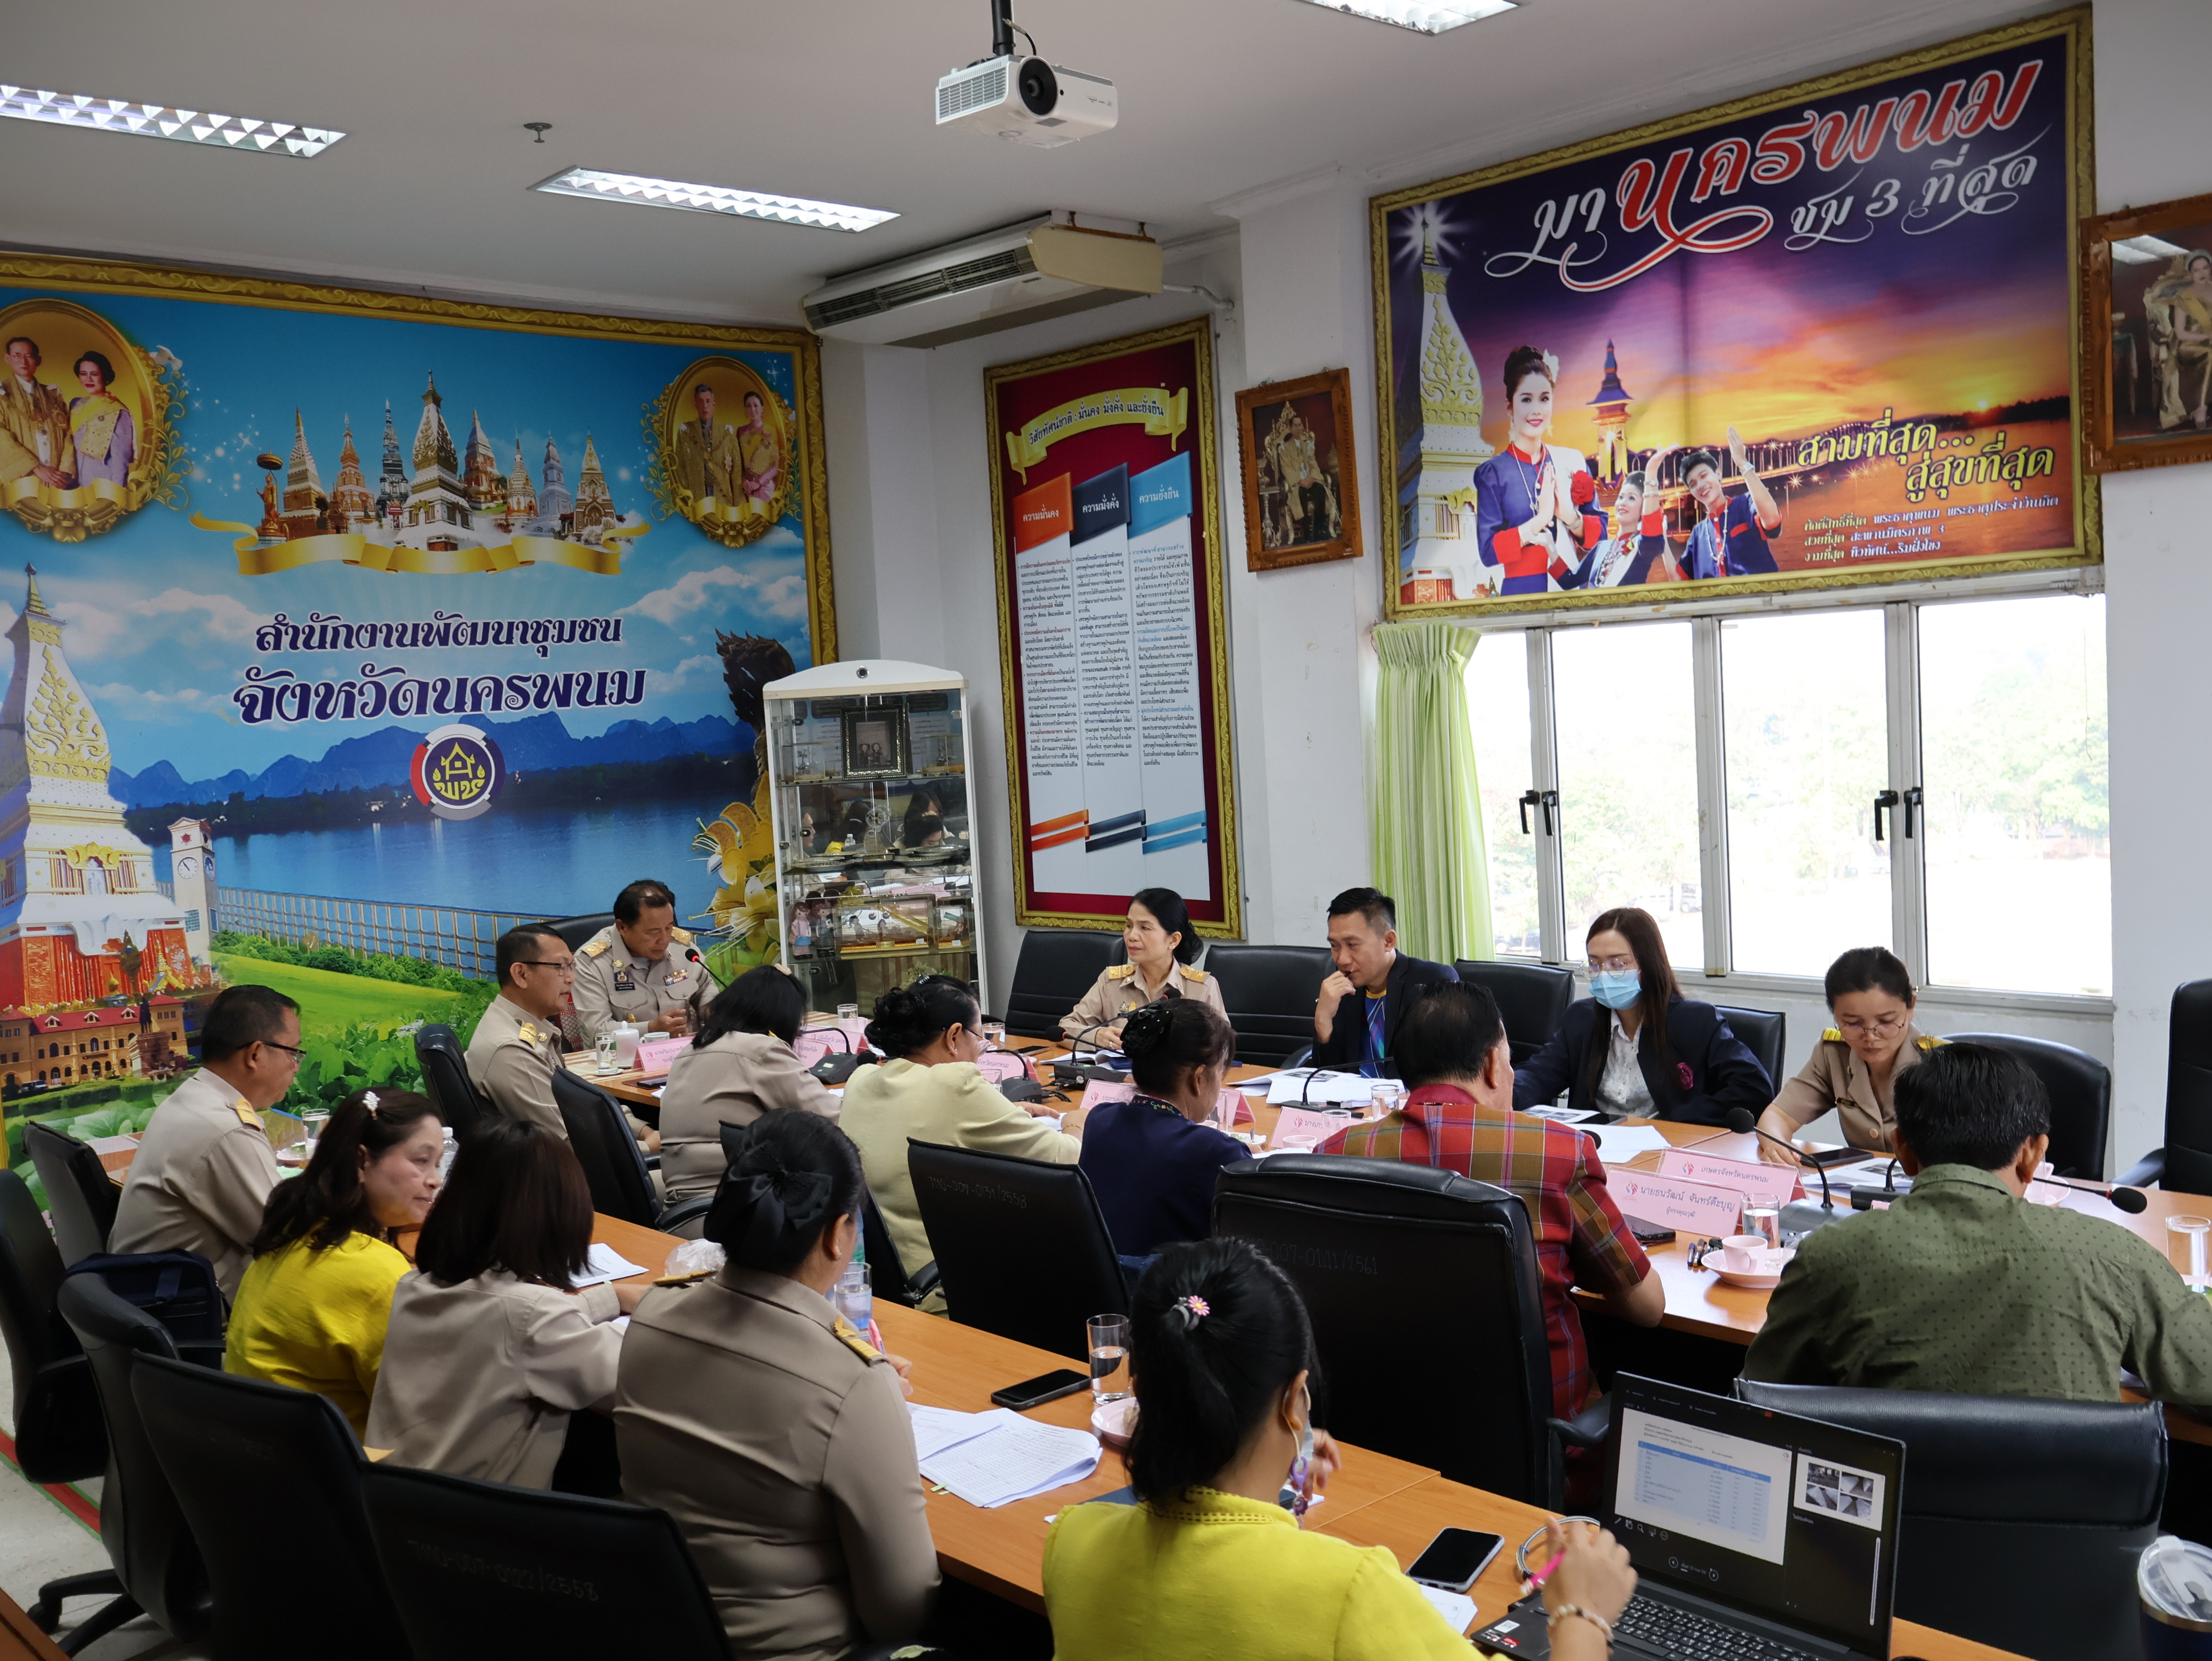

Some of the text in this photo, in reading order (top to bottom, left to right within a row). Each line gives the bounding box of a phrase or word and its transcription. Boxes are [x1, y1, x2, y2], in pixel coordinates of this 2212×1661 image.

[1865, 178, 1900, 216] 3
[1103, 394, 1123, 414] มั่งคั่ง
[1127, 394, 1164, 416] และยั่งยืน
[1906, 431, 2055, 502] สู่สุขที่สุด
[1082, 493, 1119, 513] ความมั่งคั่ง
[1139, 485, 1179, 503] ความยั่งยืน
[1023, 505, 1059, 522] ความมั่นคง
[1804, 529, 1845, 547] สวยที่สุด
[1938, 524, 1945, 534] 3
[1805, 545, 1845, 563] งามที่สุด
[255, 610, 622, 658] สำนักงานพัฒนาชุมชน
[233, 663, 646, 725] จังหวัดนครพนม
[1701, 1166, 1769, 1183] เกษตรจังหวัดนครพนม
[1640, 1185, 1685, 1201] นายธนวัฒน์
